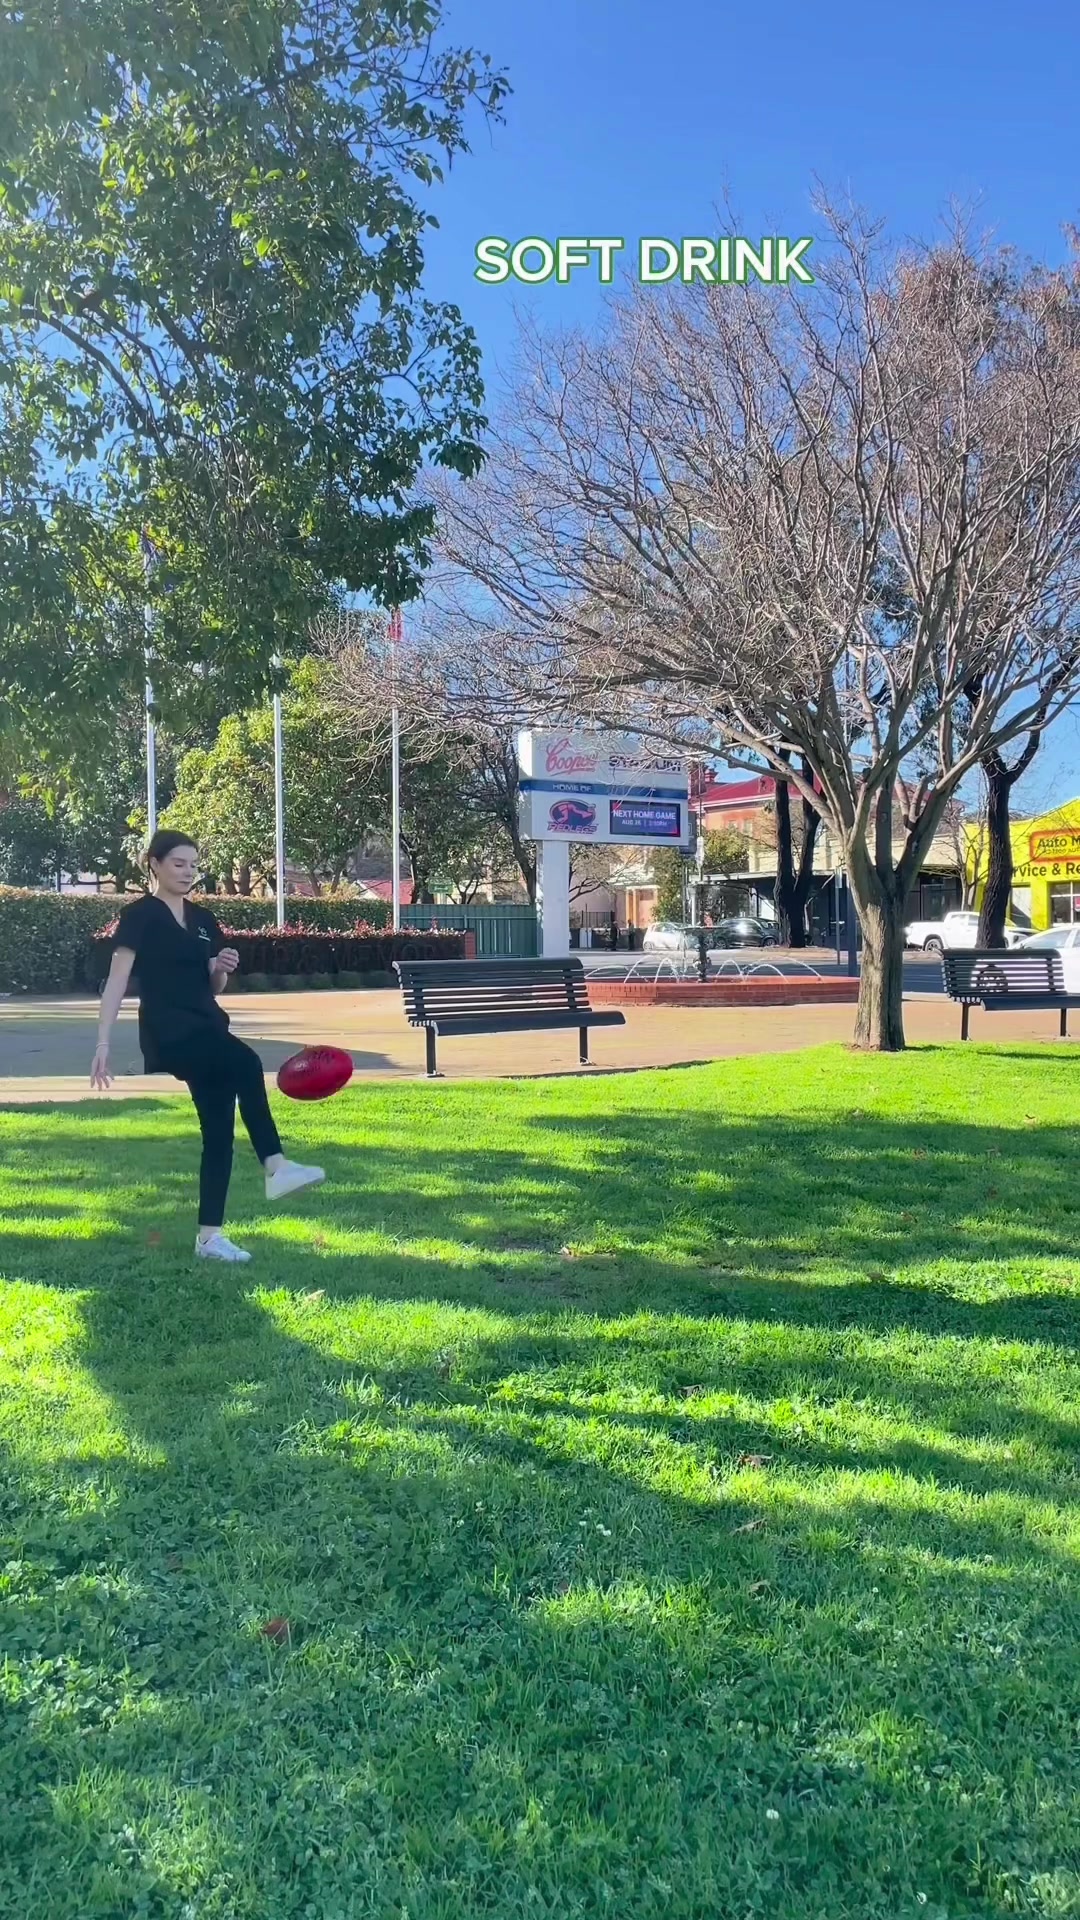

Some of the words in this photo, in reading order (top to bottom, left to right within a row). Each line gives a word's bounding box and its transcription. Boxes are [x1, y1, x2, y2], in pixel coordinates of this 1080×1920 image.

[613, 810, 633, 818] NEXT
[634, 810, 654, 819] HOME
[655, 811, 676, 820] GAME
[547, 821, 598, 834] REDLEGS
[1036, 837, 1067, 849] Auto
[1013, 864, 1046, 877] rvice
[1052, 863, 1061, 876] &
